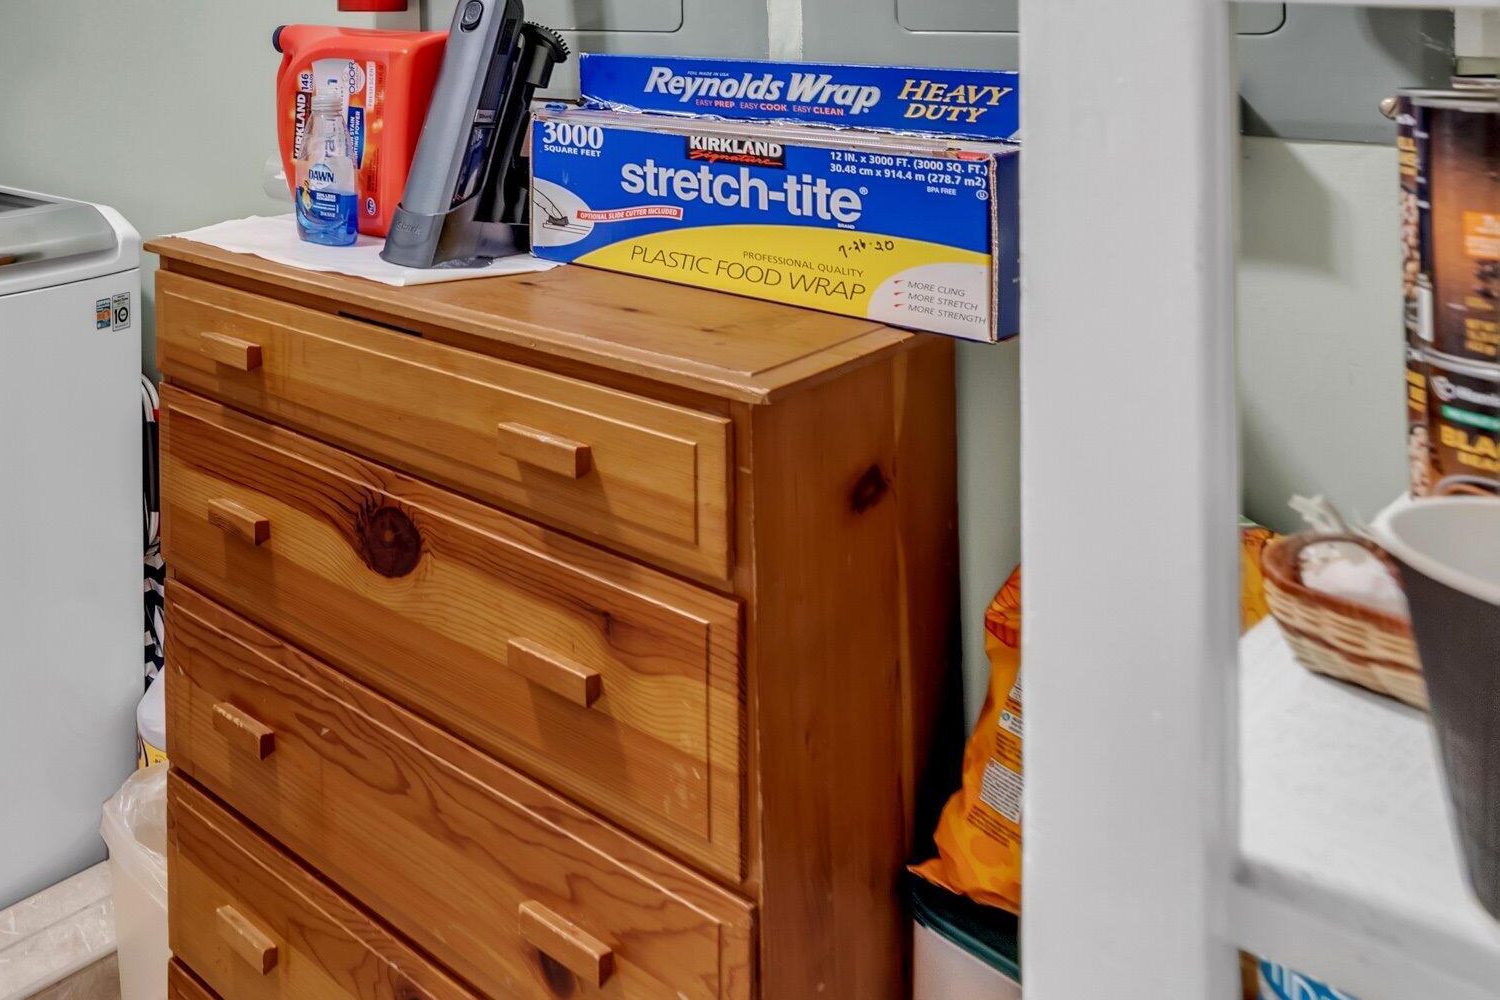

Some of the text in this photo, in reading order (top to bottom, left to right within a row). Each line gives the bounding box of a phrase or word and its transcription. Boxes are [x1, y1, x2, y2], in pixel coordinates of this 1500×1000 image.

[301, 73, 309, 90] 146
[644, 66, 881, 115] Reynolds Wrap
[898, 78, 1013, 106] HEAVY
[714, 100, 735, 108] PREP
[740, 102, 759, 110] EASY
[760, 103, 787, 111] COOK
[793, 105, 812, 113] EASY
[813, 107, 844, 116] CLEAN
[904, 104, 987, 123] DUTY
[542, 121, 604, 149] 3000
[544, 144, 602, 158] SQUARE FEET
[690, 135, 783, 158] KIRKLAND
[830, 151, 988, 177] 12 IN. x 3000 FT. (3000 SQ. FT.)
[308, 169, 335, 183] DAWN
[830, 163, 986, 189] 30.48 cm x 914.4 m (278.7 m2)
[621, 158, 862, 223] stretch-tite
[926, 186, 957, 196] BPA FREE
[580, 208, 678, 220] OPTIONAL SLIDE CUTTER INCLUDED
[630, 245, 866, 300] PLASTIC FOOD WRAP
[743, 250, 864, 278] PROFESSIONAL QUALITY
[907, 281, 965, 297] MORE CLING
[907, 292, 979, 311] MORE STRETCH
[907, 304, 986, 325] MORE STRENGTH
